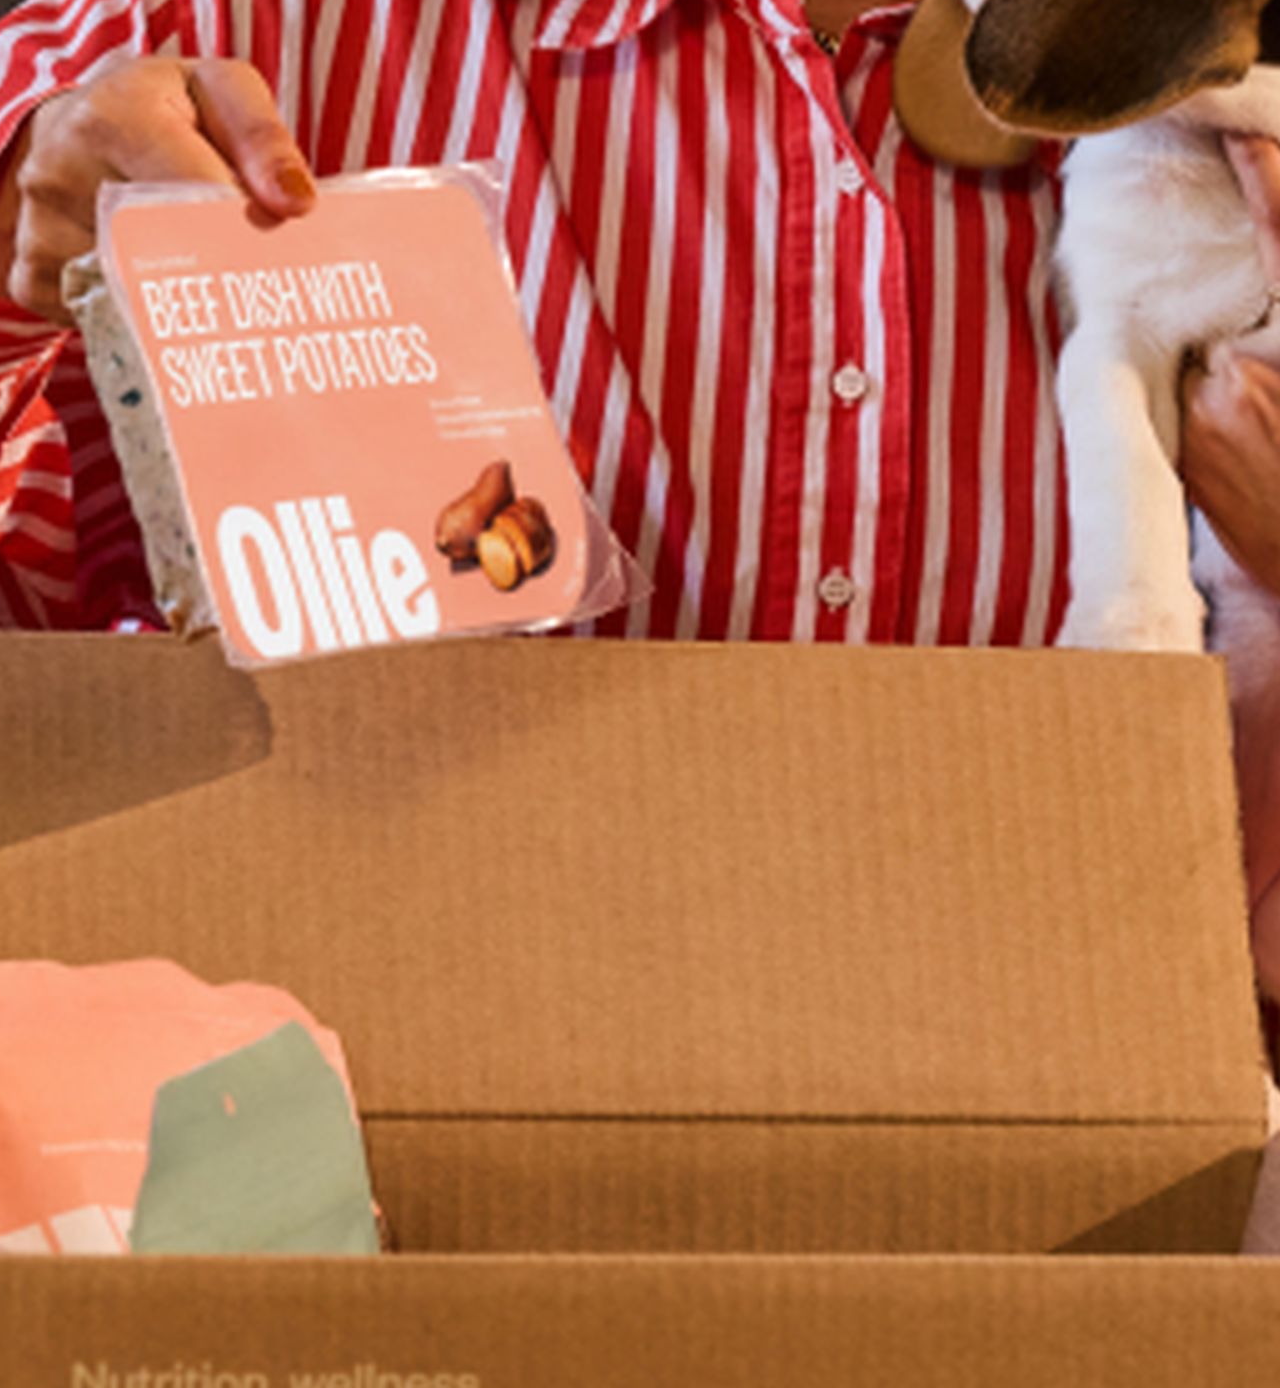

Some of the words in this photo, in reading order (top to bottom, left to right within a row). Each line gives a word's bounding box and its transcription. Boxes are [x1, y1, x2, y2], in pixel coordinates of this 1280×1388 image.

[140, 273, 219, 339] BEEF
[221, 267, 307, 330] DISH
[298, 260, 393, 323] WITH
[160, 338, 274, 408] SWEET
[273, 323, 438, 396] POTATOES
[216, 495, 441, 659] Ollie
